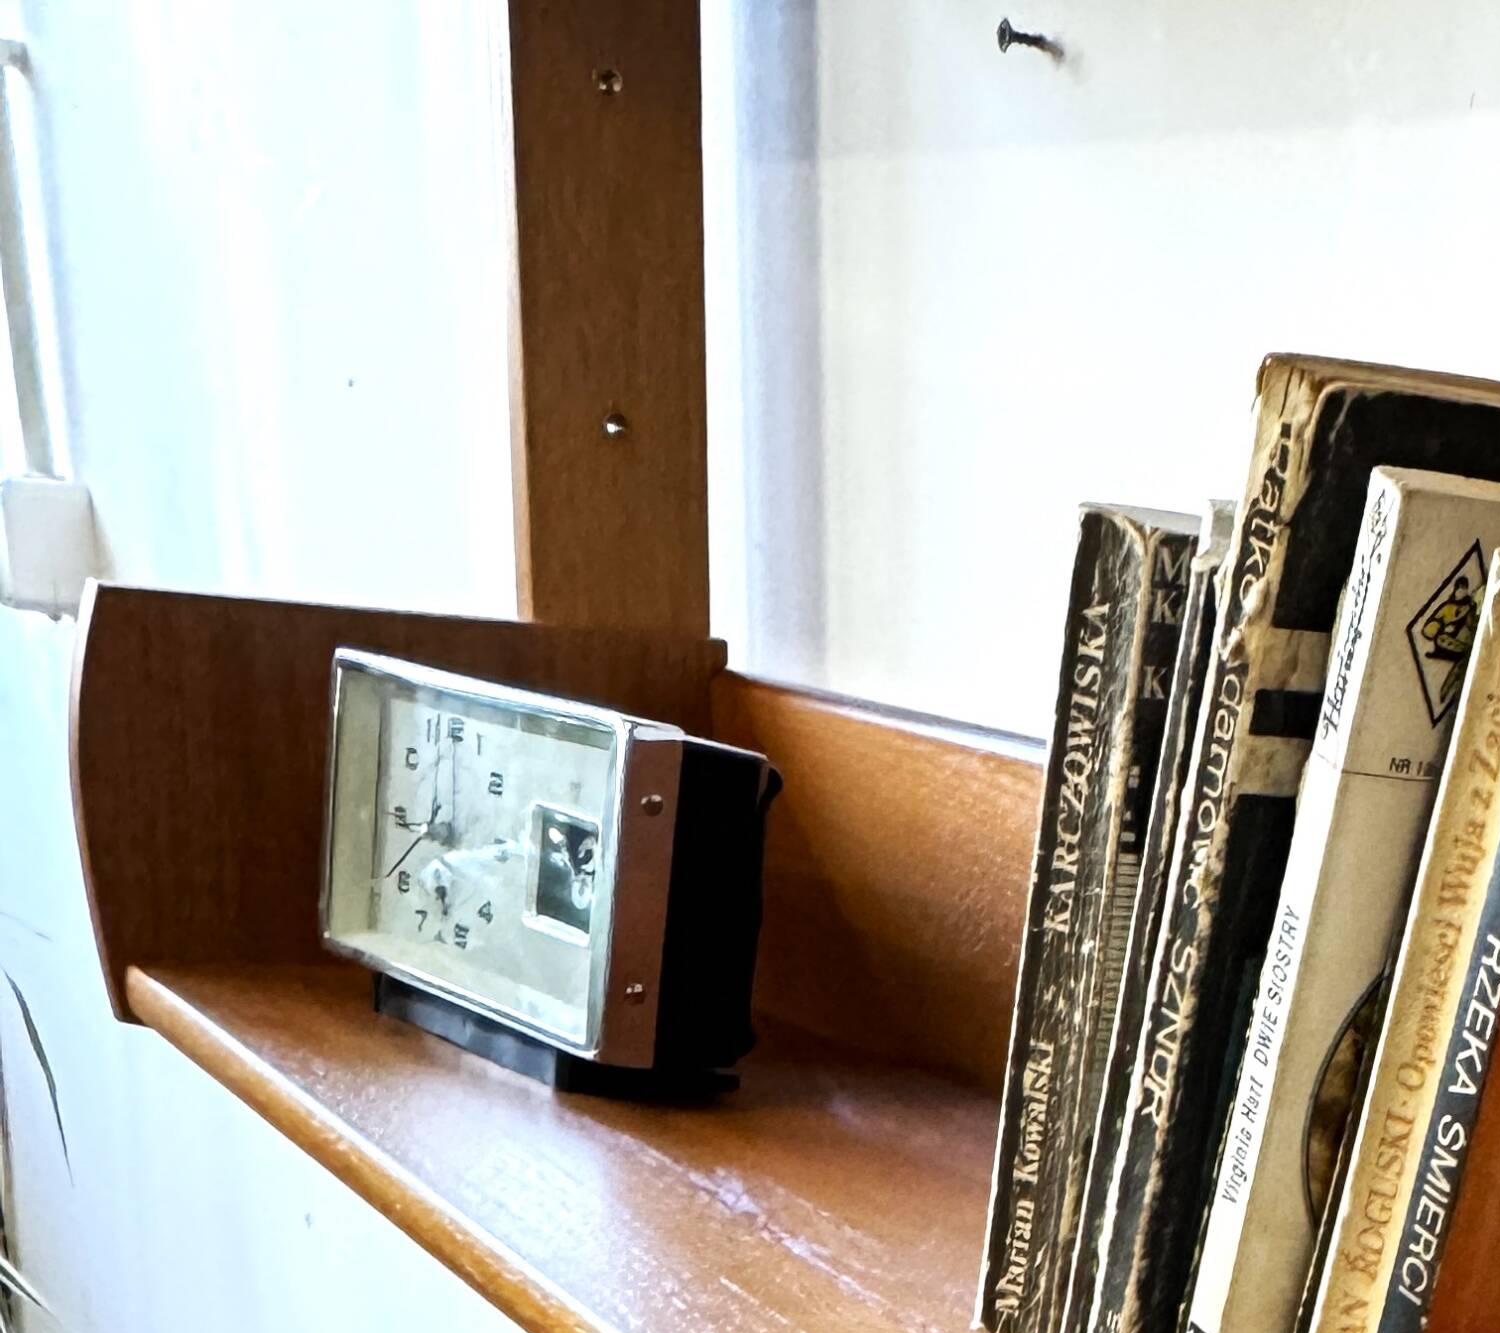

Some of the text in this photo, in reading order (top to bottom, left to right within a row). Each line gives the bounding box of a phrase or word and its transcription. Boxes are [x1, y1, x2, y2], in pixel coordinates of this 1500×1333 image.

[1043, 602, 1109, 932] KARCZOWISKA
[1388, 757, 1411, 774] NR
[1253, 1010, 1279, 1066] DWIE
[1268, 904, 1302, 1006] SIOSTRY
[1398, 1114, 1468, 1307] ŚMIERCI
